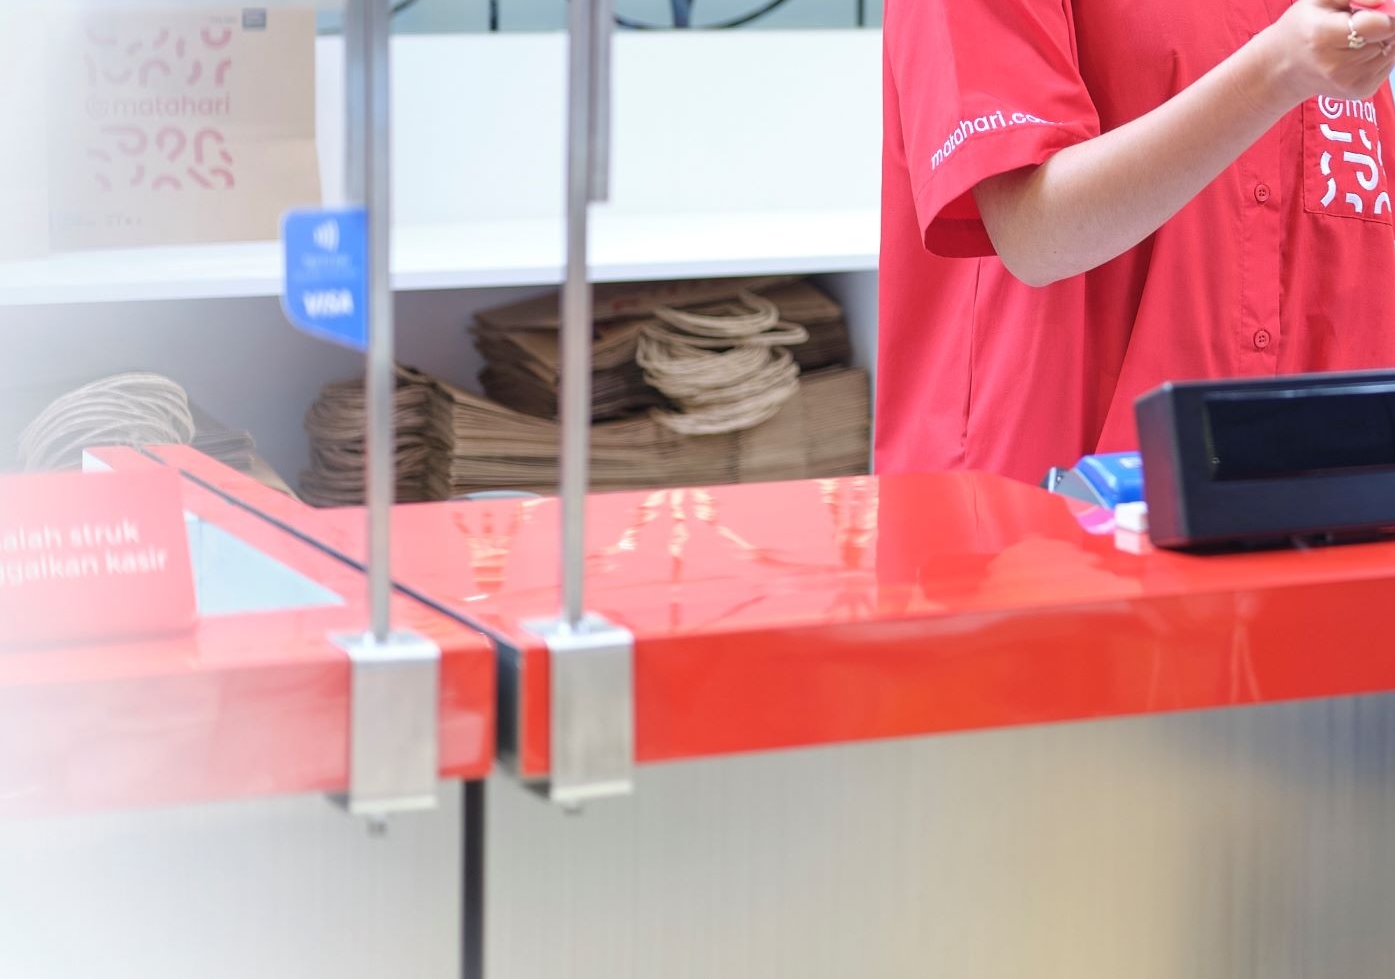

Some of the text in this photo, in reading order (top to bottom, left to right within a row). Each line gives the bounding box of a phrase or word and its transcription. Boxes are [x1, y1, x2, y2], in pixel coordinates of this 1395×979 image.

[113, 91, 231, 117] matahari
[931, 110, 1063, 170] matahari.co
[302, 287, 355, 317] VISA
[2, 515, 141, 552] alah struk
[0, 542, 168, 589] galkan kasir
